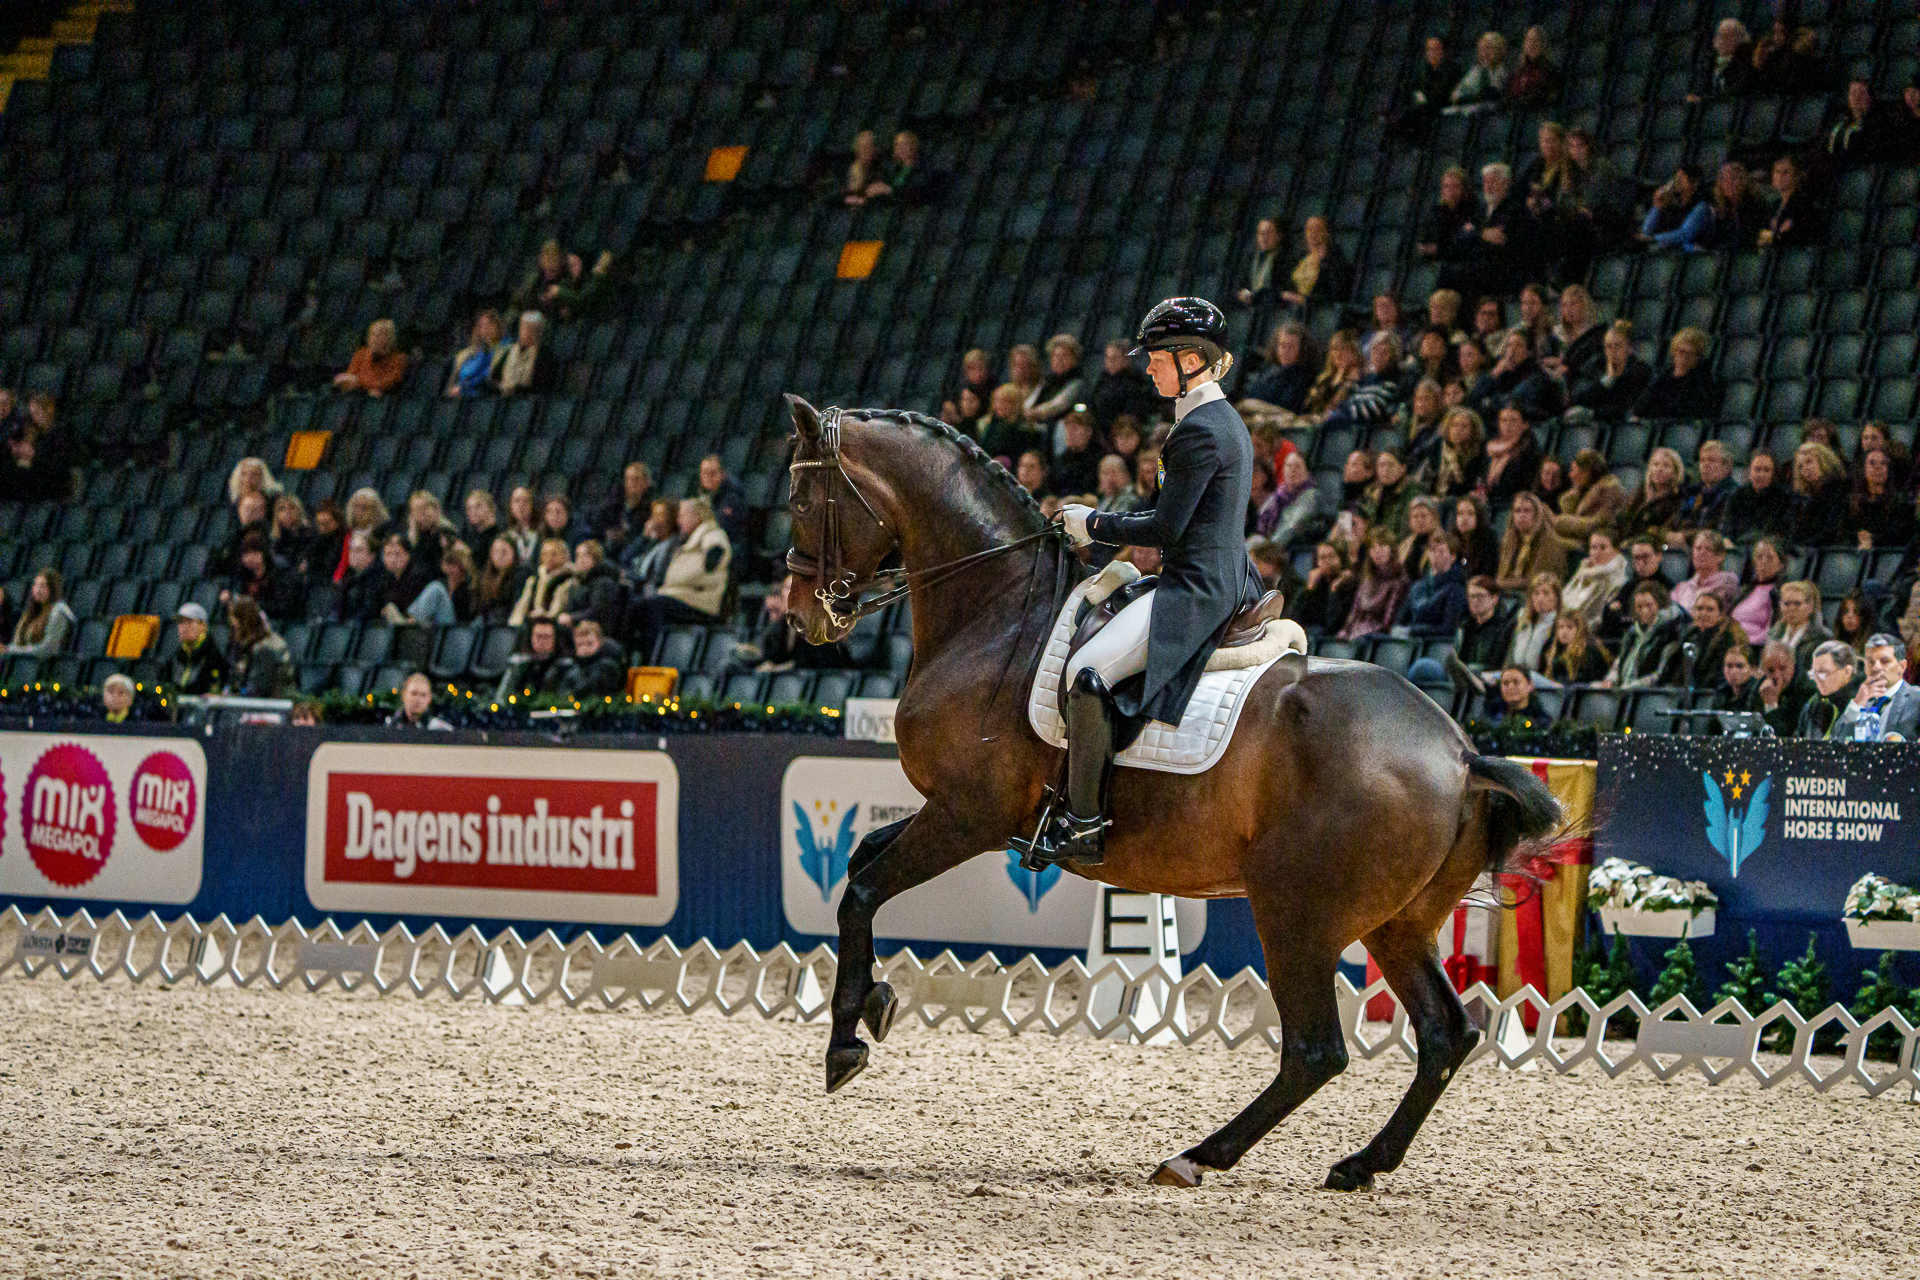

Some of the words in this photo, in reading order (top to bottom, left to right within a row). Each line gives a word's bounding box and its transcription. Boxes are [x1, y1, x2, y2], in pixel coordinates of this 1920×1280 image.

[1785, 776, 1847, 796] SWEDEN
[135, 807, 187, 835] MEGAPOL
[1785, 798, 1901, 821] INTERNATIONAL
[30, 822, 102, 862] MEGAPOL
[345, 791, 482, 878] Dagens
[486, 795, 636, 870] industri
[1784, 820, 1833, 840] HORSE
[1835, 822, 1884, 842] SHOW
[1103, 887, 1151, 956] E
